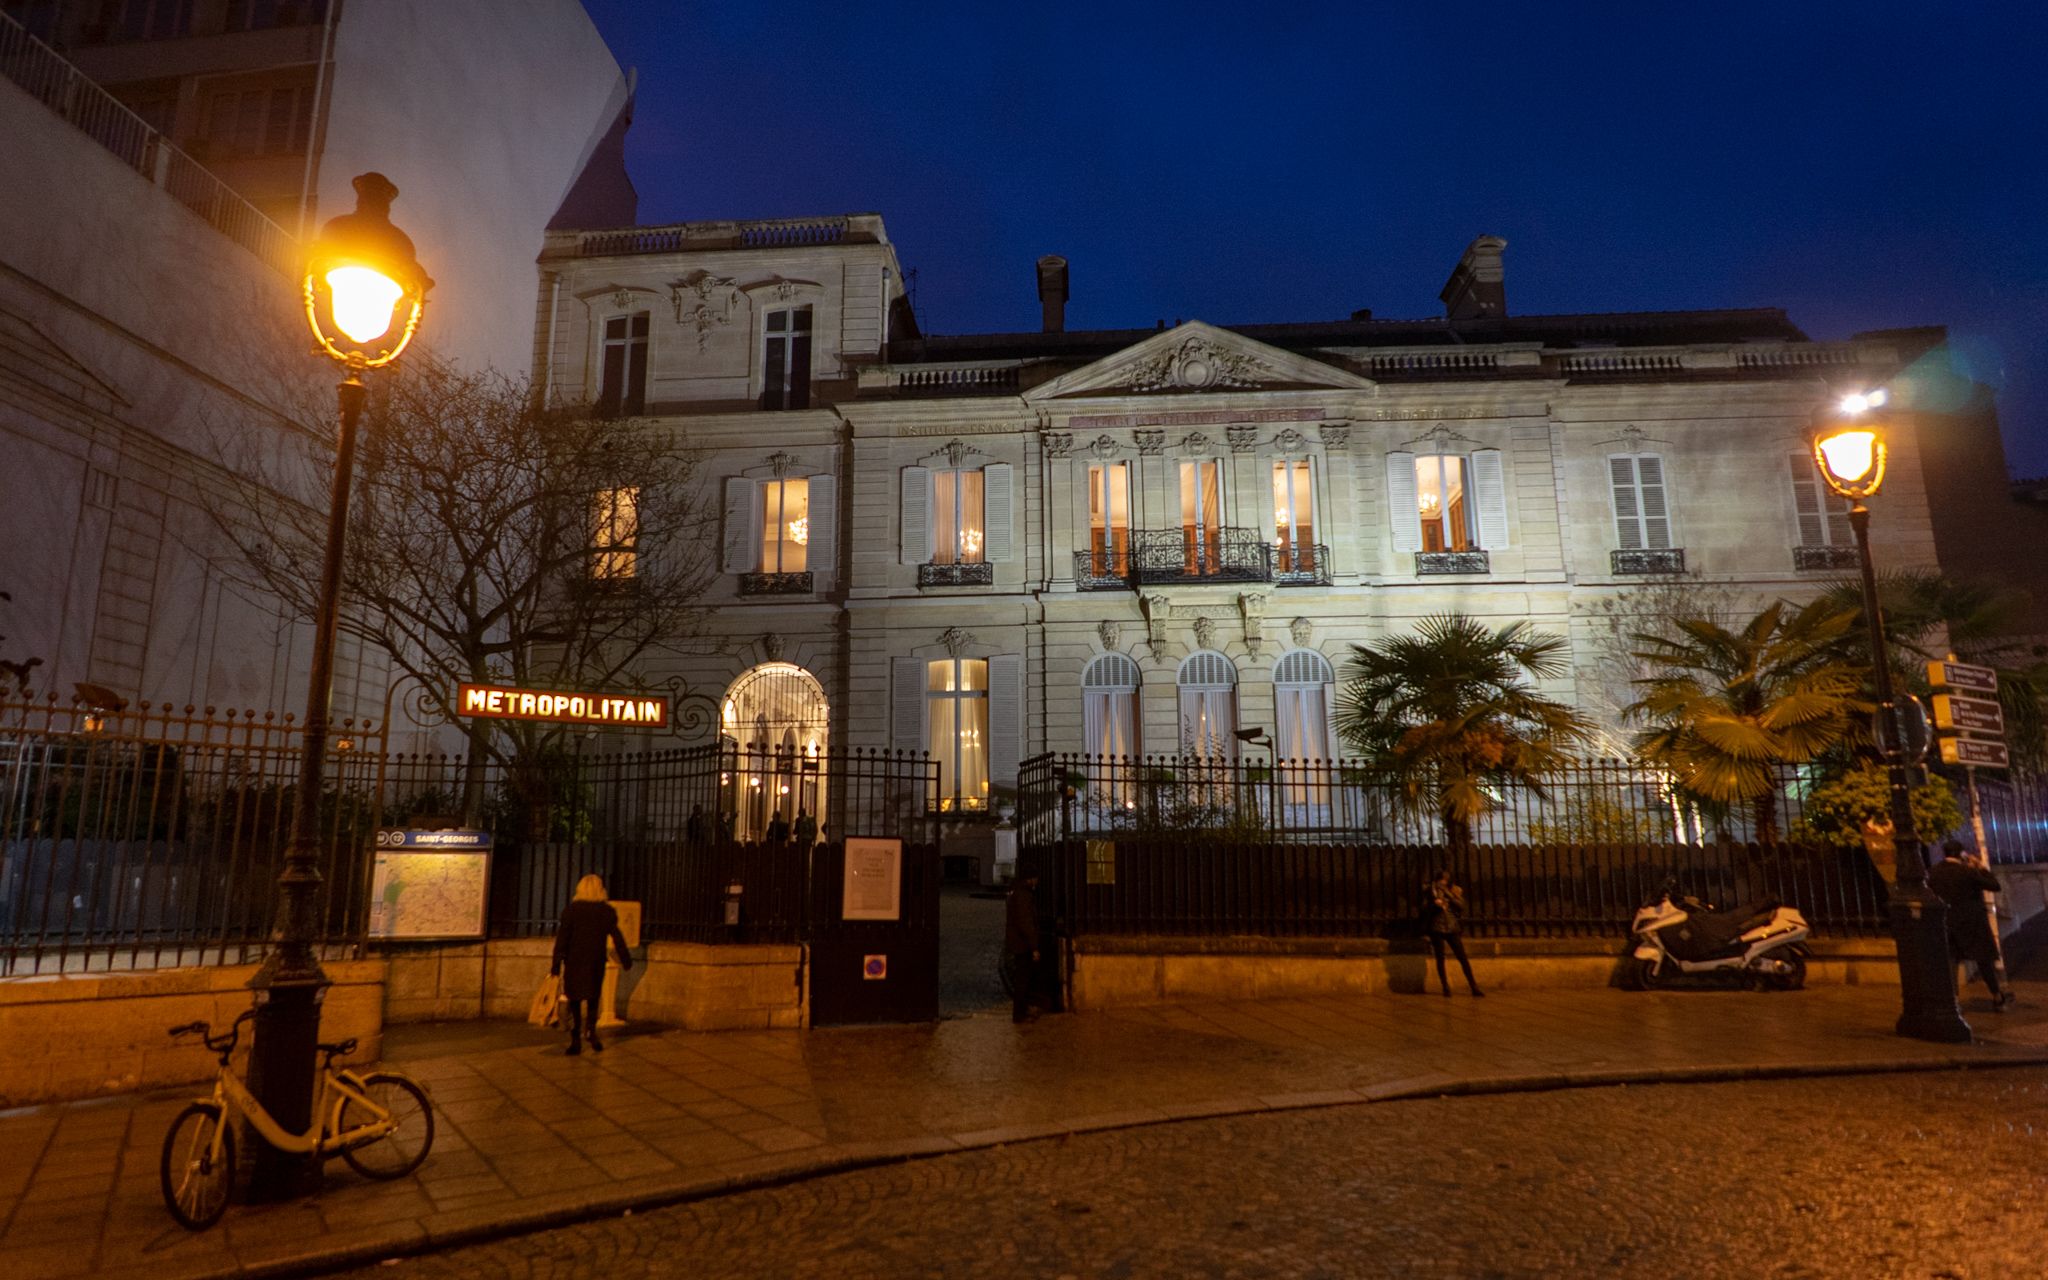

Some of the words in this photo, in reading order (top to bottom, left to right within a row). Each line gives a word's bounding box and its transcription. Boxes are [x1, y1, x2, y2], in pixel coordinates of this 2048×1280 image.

[897, 425, 950, 436] INSTITUT
[970, 423, 1017, 434] FRANCE
[466, 689, 661, 722] METROPOLITAIN
[415, 834, 479, 844] SAINT-GEORGES
